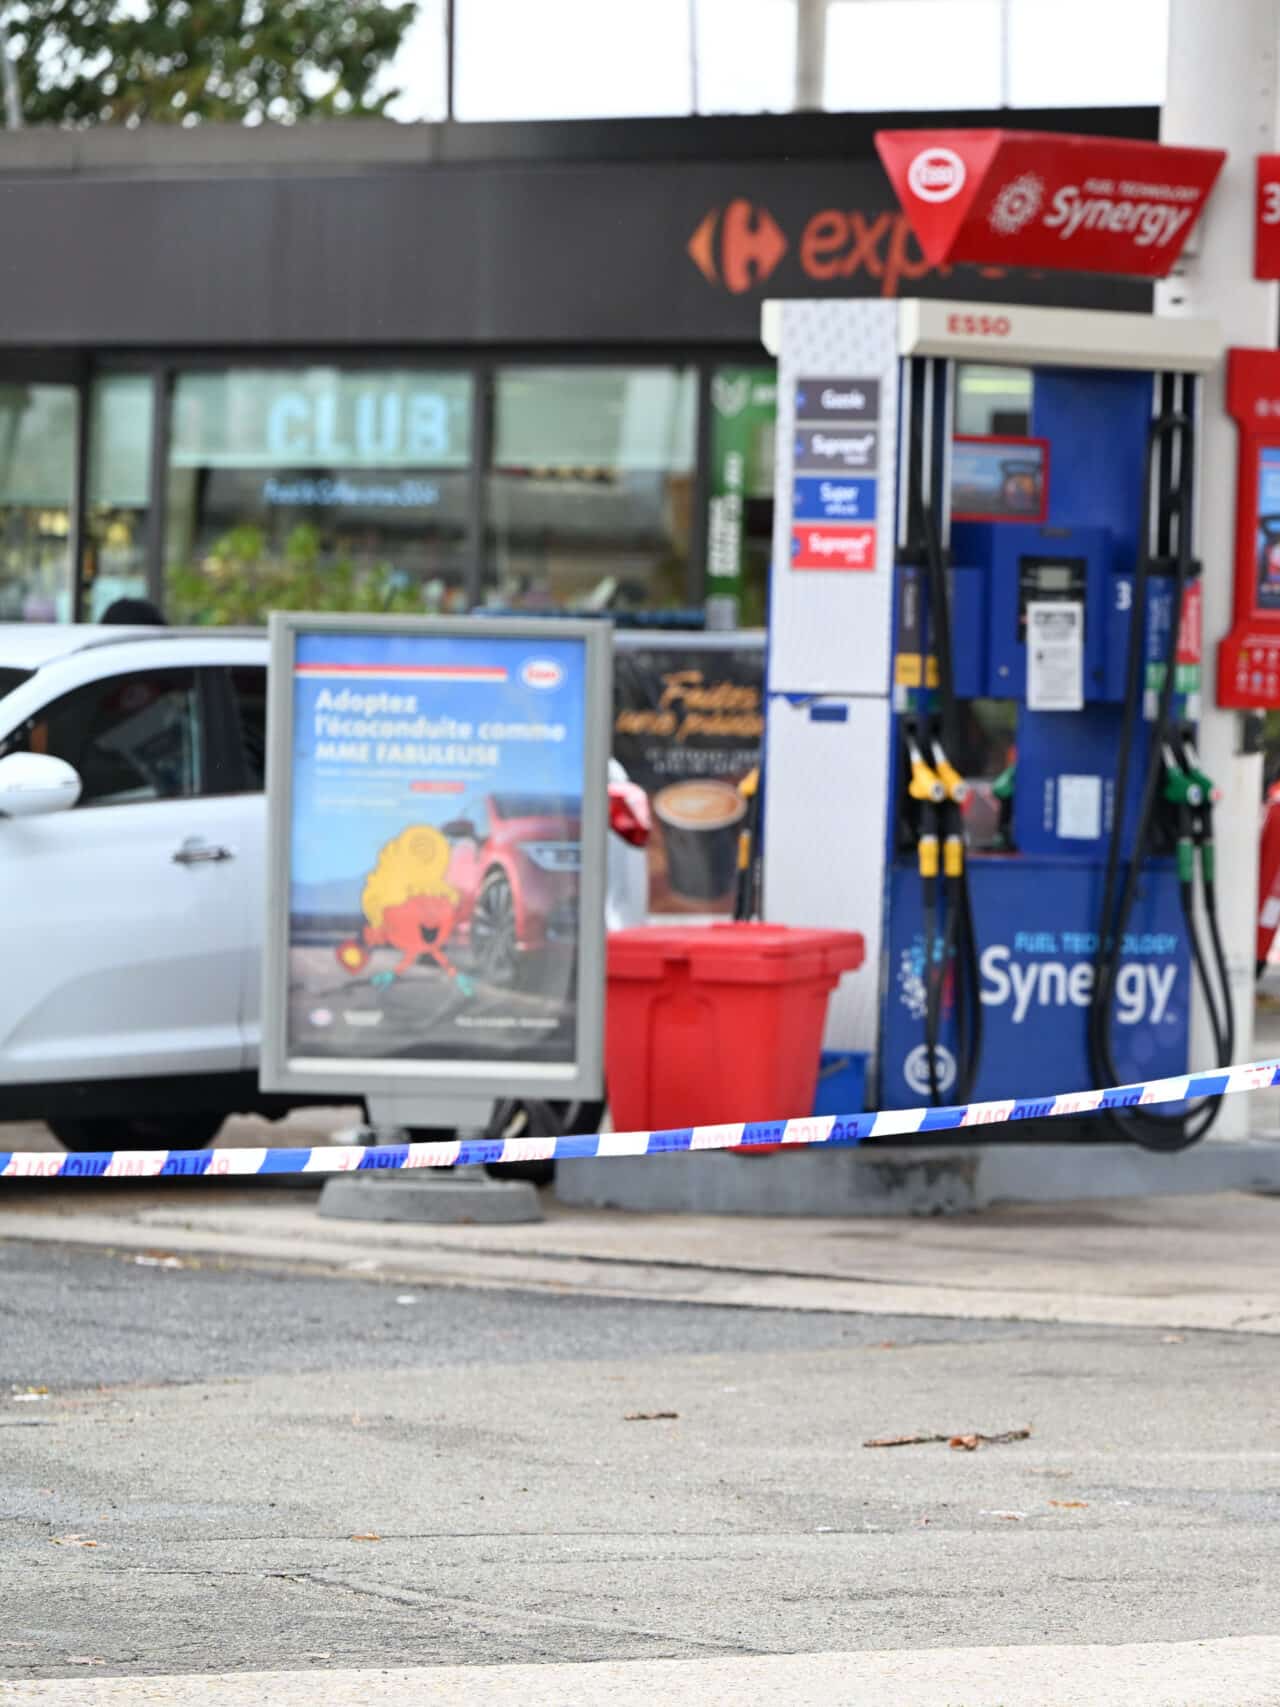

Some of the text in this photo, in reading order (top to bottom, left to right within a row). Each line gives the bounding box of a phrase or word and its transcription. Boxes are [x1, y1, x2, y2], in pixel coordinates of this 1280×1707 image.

[1043, 186, 1191, 247] Synergy
[947, 313, 1011, 336] ESSO
[266, 390, 450, 456] CLUB
[1115, 581, 1132, 611] 3
[314, 688, 419, 716] Adoptez
[478, 720, 566, 743] comme
[314, 743, 500, 766] MME FABULEUSE
[1015, 932, 1059, 953] FUEL
[979, 945, 1178, 1024] Synegy
